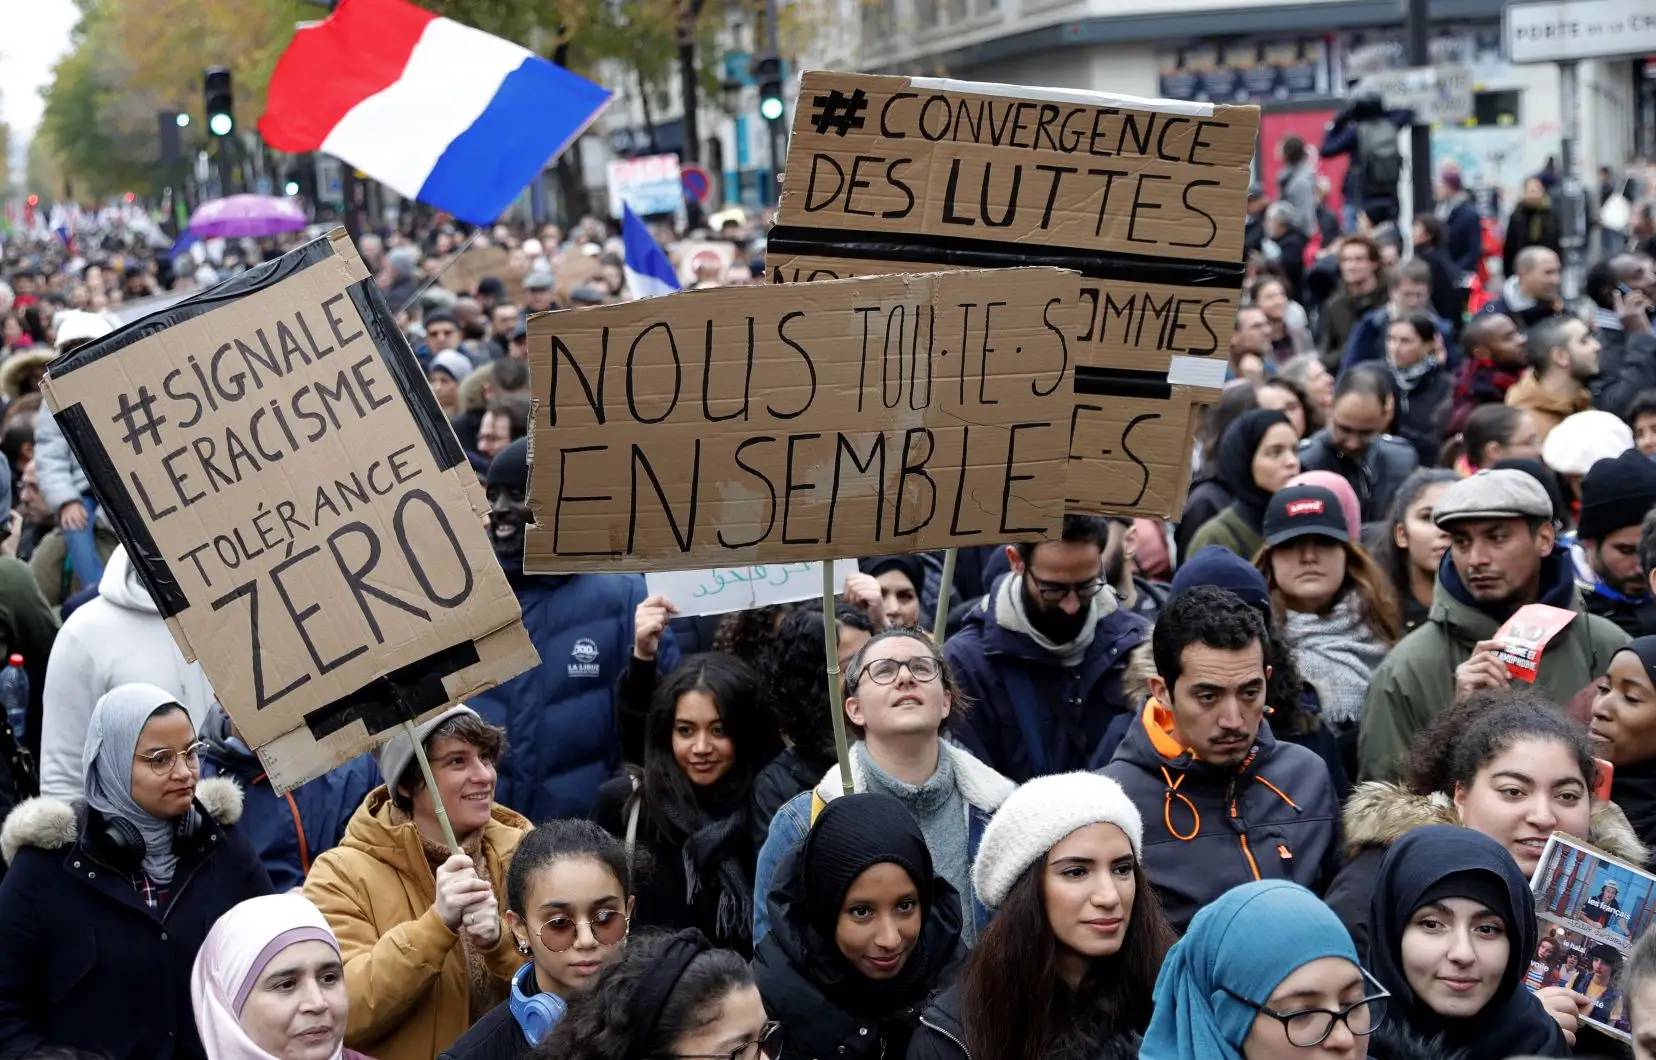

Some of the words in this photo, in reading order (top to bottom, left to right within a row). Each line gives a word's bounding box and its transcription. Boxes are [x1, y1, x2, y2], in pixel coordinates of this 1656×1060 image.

[804, 153, 915, 219] DES
[942, 158, 1221, 248] LUTTES
[549, 311, 817, 427] NOUS
[178, 444, 423, 587] TOLÉRANCE
[553, 422, 1052, 556] ENSEMBLE
[211, 488, 475, 711] ZÉRO
[1530, 960, 1550, 972] voile
[1587, 897, 1600, 908] les
[1599, 901, 1632, 920] français
